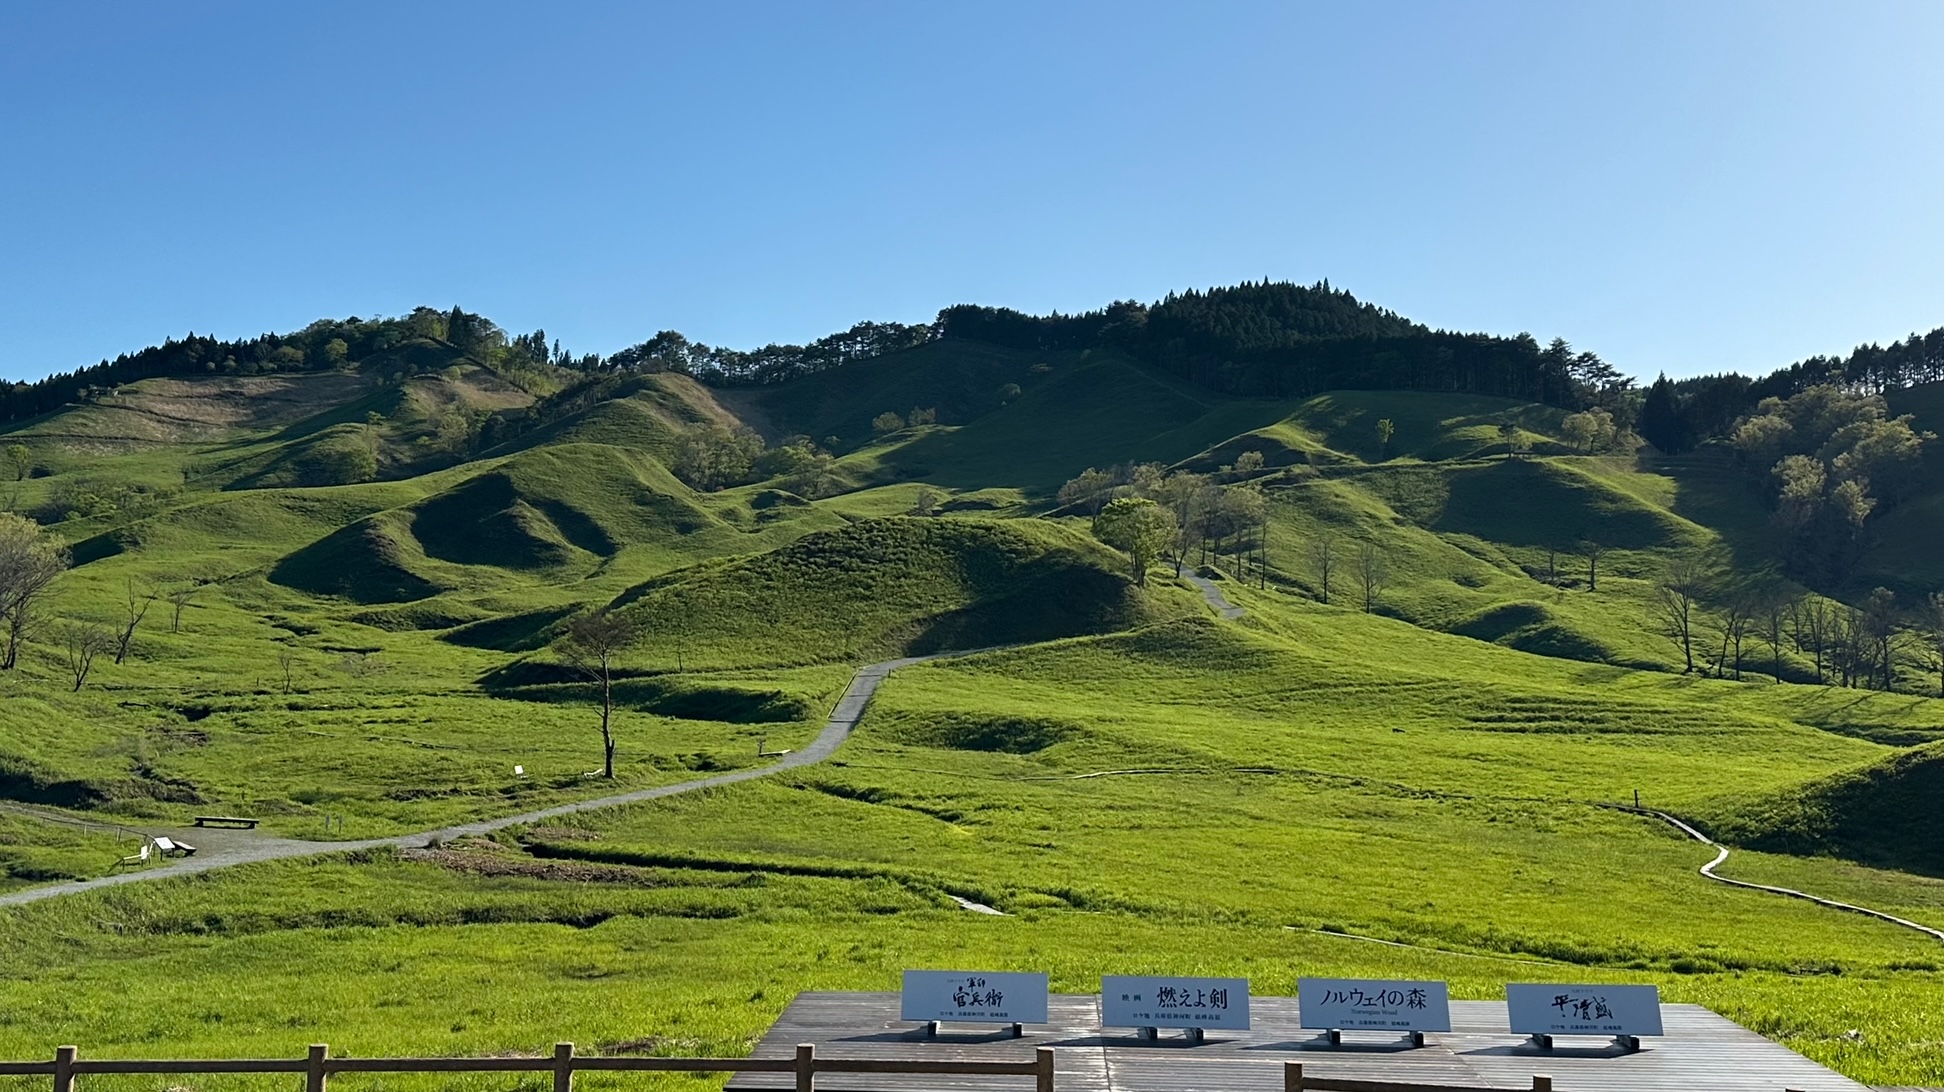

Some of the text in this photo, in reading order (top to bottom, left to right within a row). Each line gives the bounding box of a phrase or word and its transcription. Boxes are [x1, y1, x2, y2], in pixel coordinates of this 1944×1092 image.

[1157, 986, 1227, 1009] 燃えよ剣
[1320, 987, 1427, 1009] ノルウェイの森
[1551, 994, 1613, 1020] 平清盛
